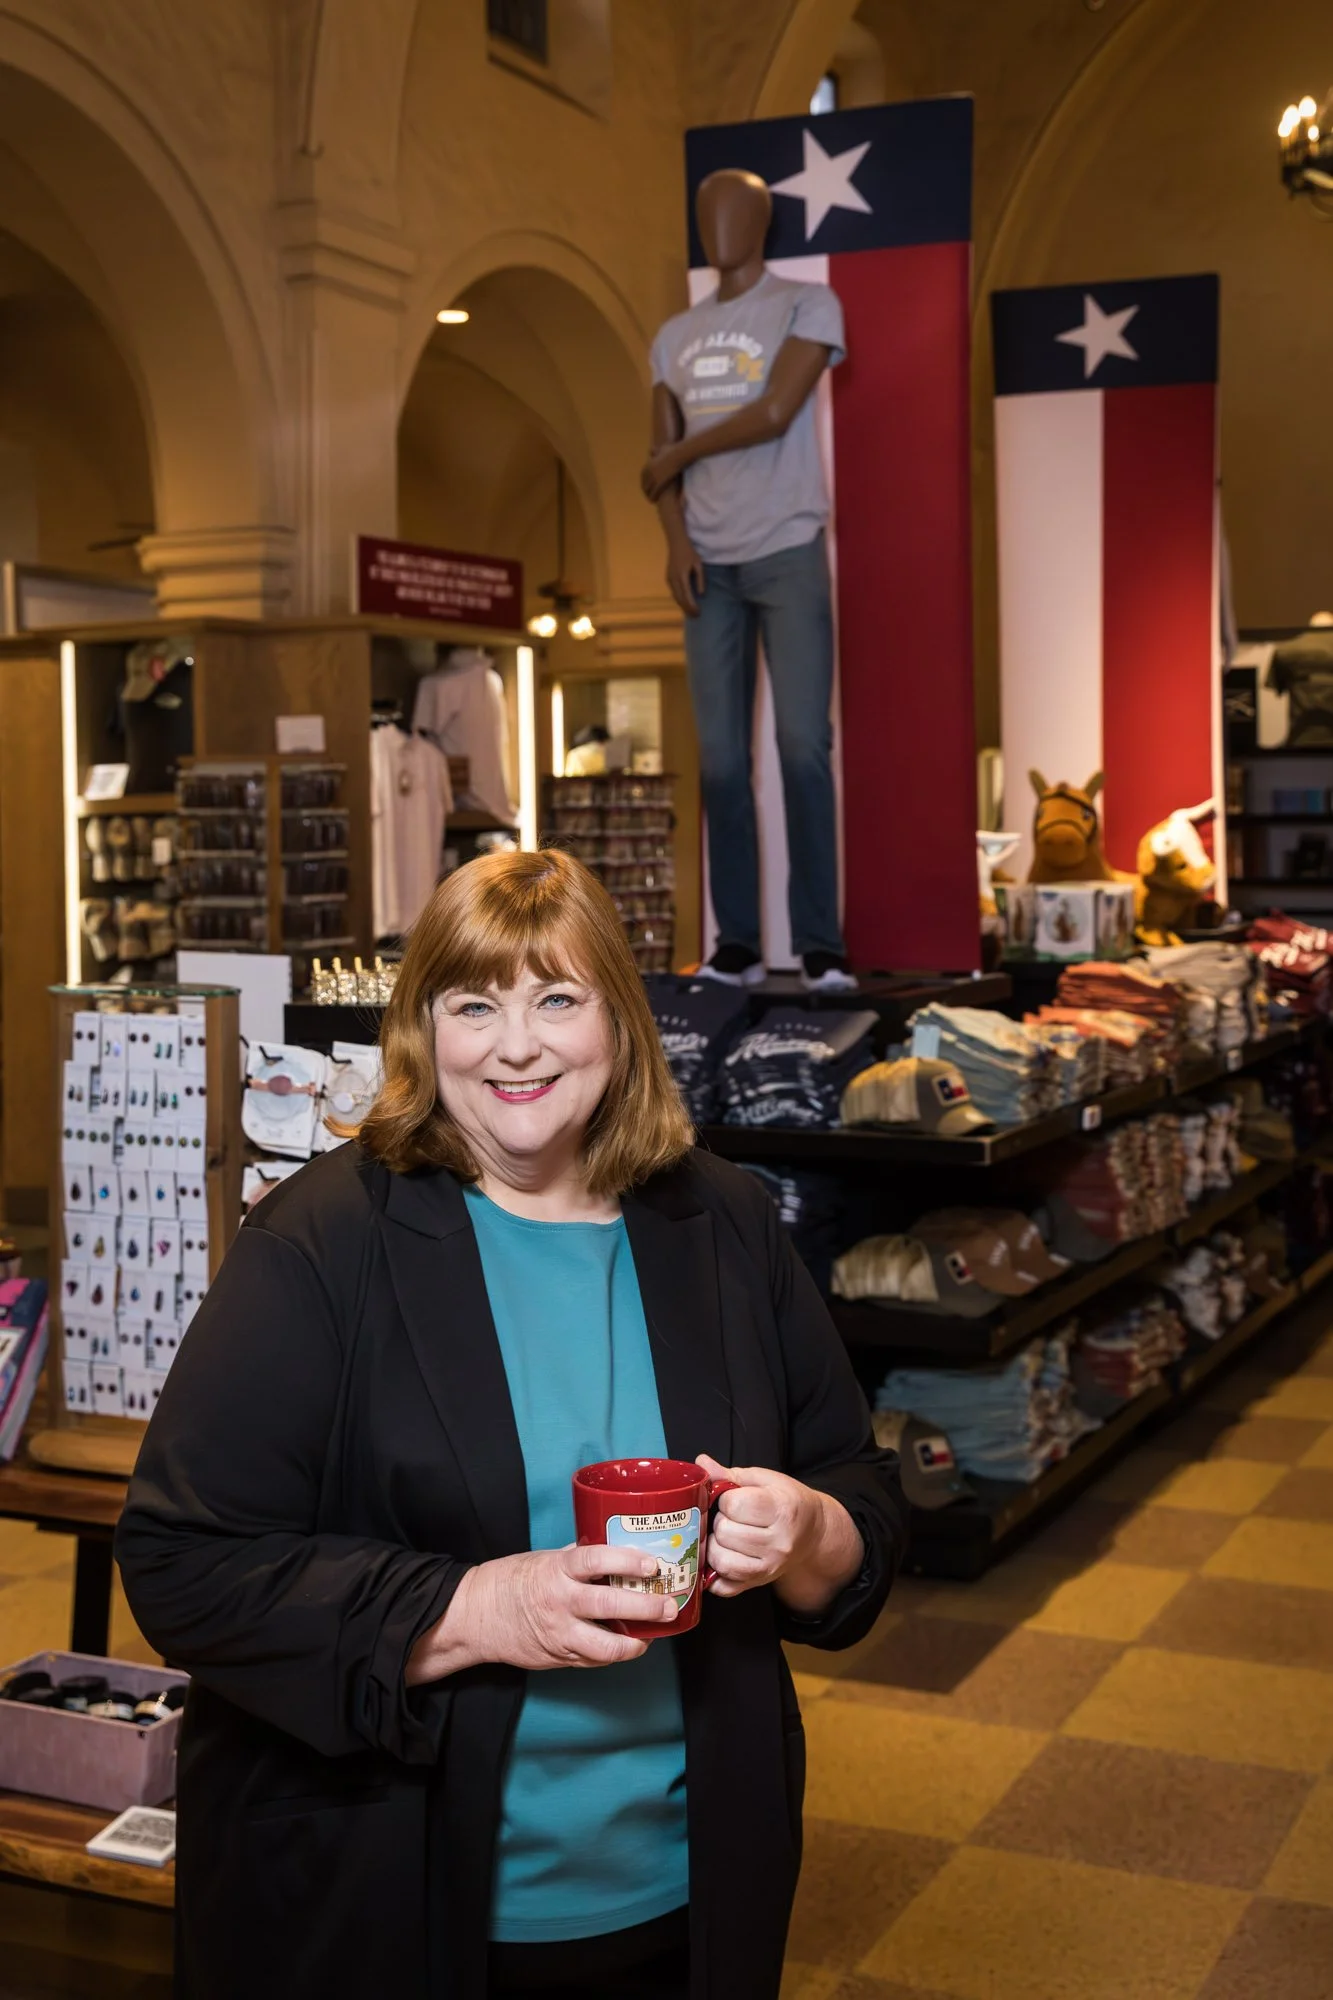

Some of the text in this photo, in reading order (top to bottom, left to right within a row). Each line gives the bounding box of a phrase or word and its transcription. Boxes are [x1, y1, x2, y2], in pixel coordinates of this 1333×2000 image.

[704, 332, 763, 358] ALAMO
[629, 1512, 686, 1526] THE ALAMO
